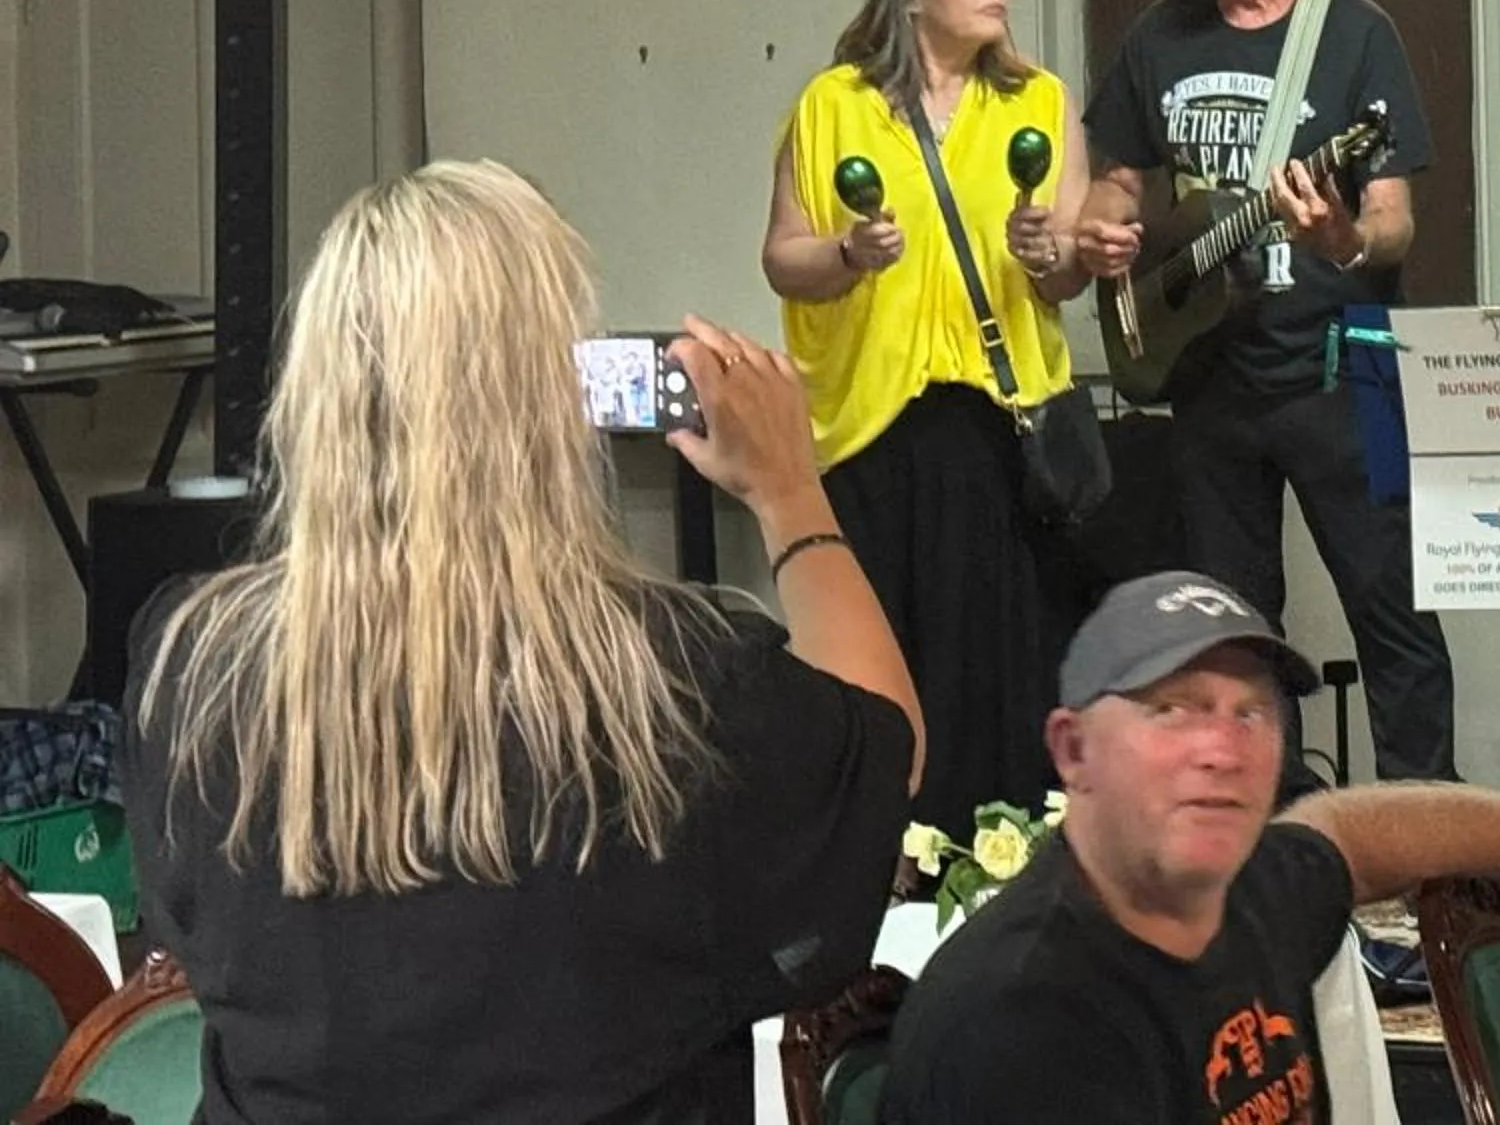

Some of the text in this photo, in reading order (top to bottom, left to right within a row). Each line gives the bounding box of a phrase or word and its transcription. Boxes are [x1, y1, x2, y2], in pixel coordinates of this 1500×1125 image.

[1229, 76, 1269, 93] HAVE
[1168, 107, 1266, 144] RETIREME
[1424, 355, 1450, 369] THE
[1427, 542, 1461, 559] Royal
[1478, 562, 1492, 574] OF
